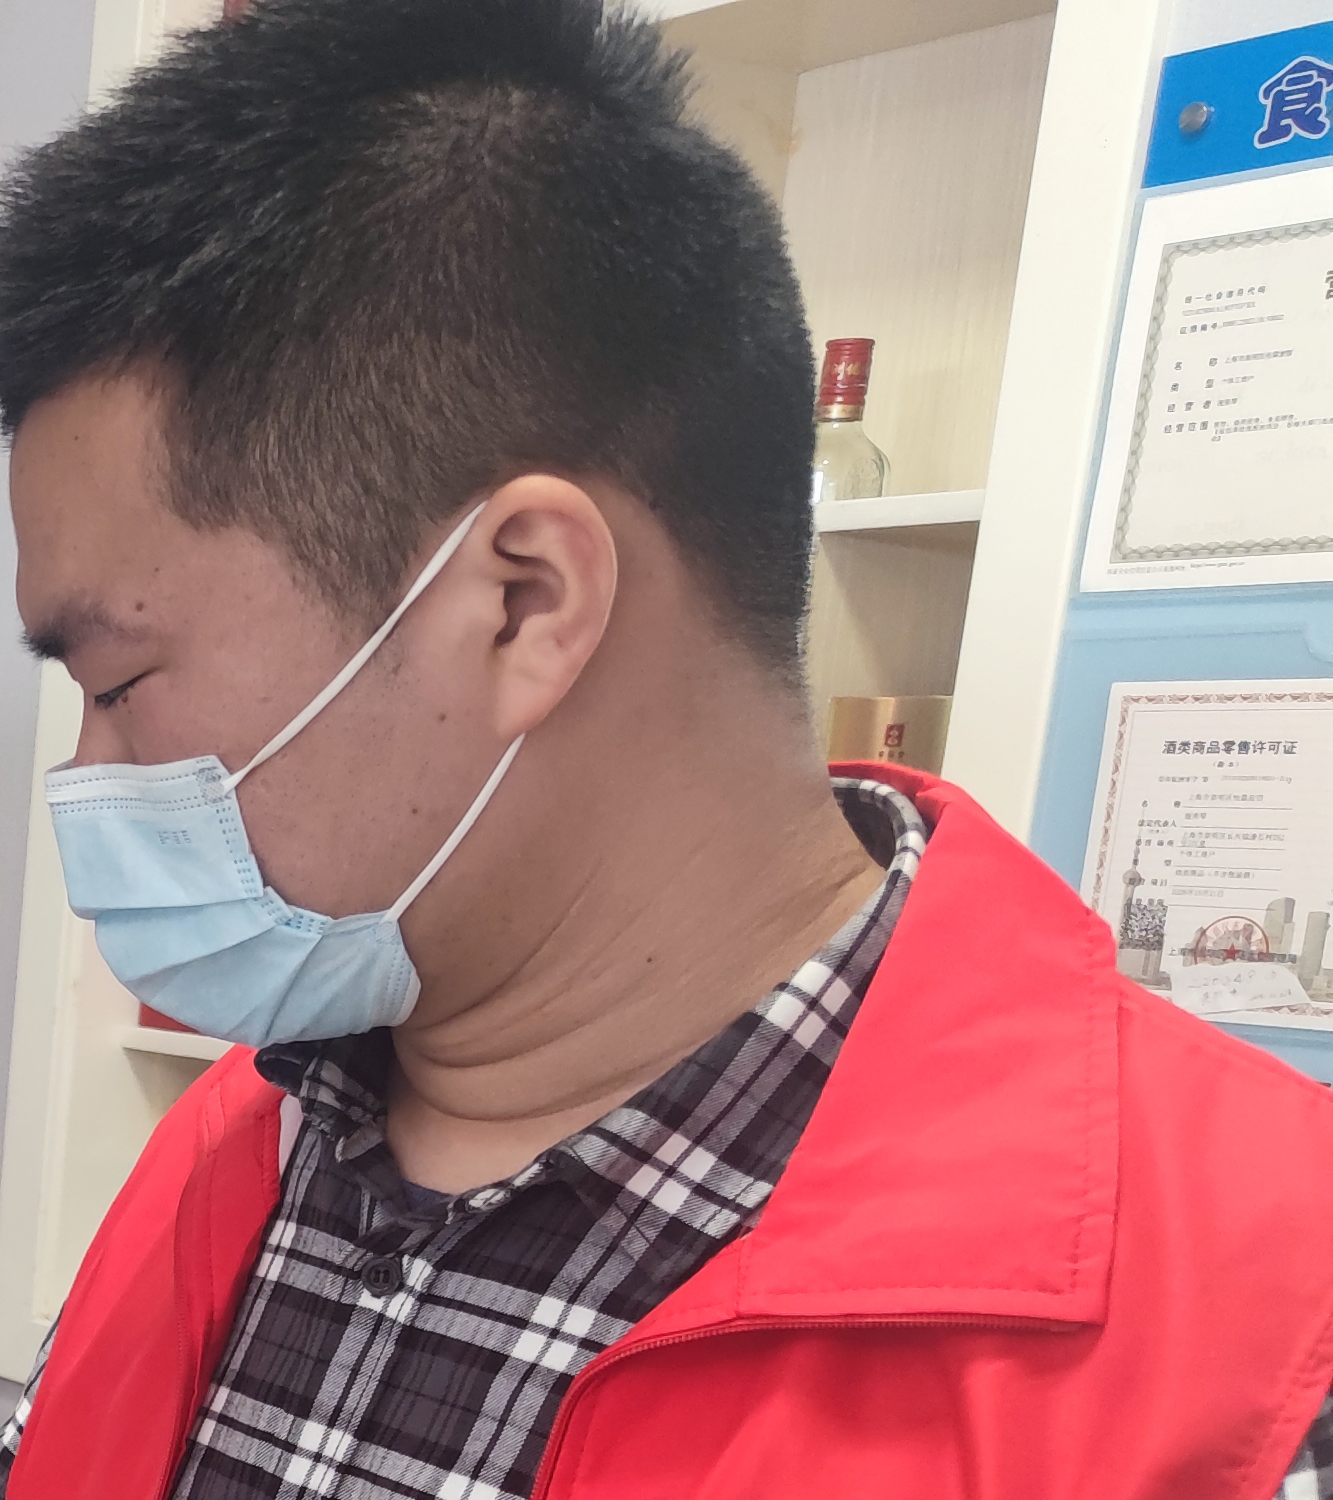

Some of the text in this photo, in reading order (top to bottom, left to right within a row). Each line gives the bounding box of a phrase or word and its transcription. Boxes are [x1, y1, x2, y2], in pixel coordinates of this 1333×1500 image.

[1254, 55, 1333, 149] 食
[1161, 739, 1299, 756] 酒类商品零售许可证
